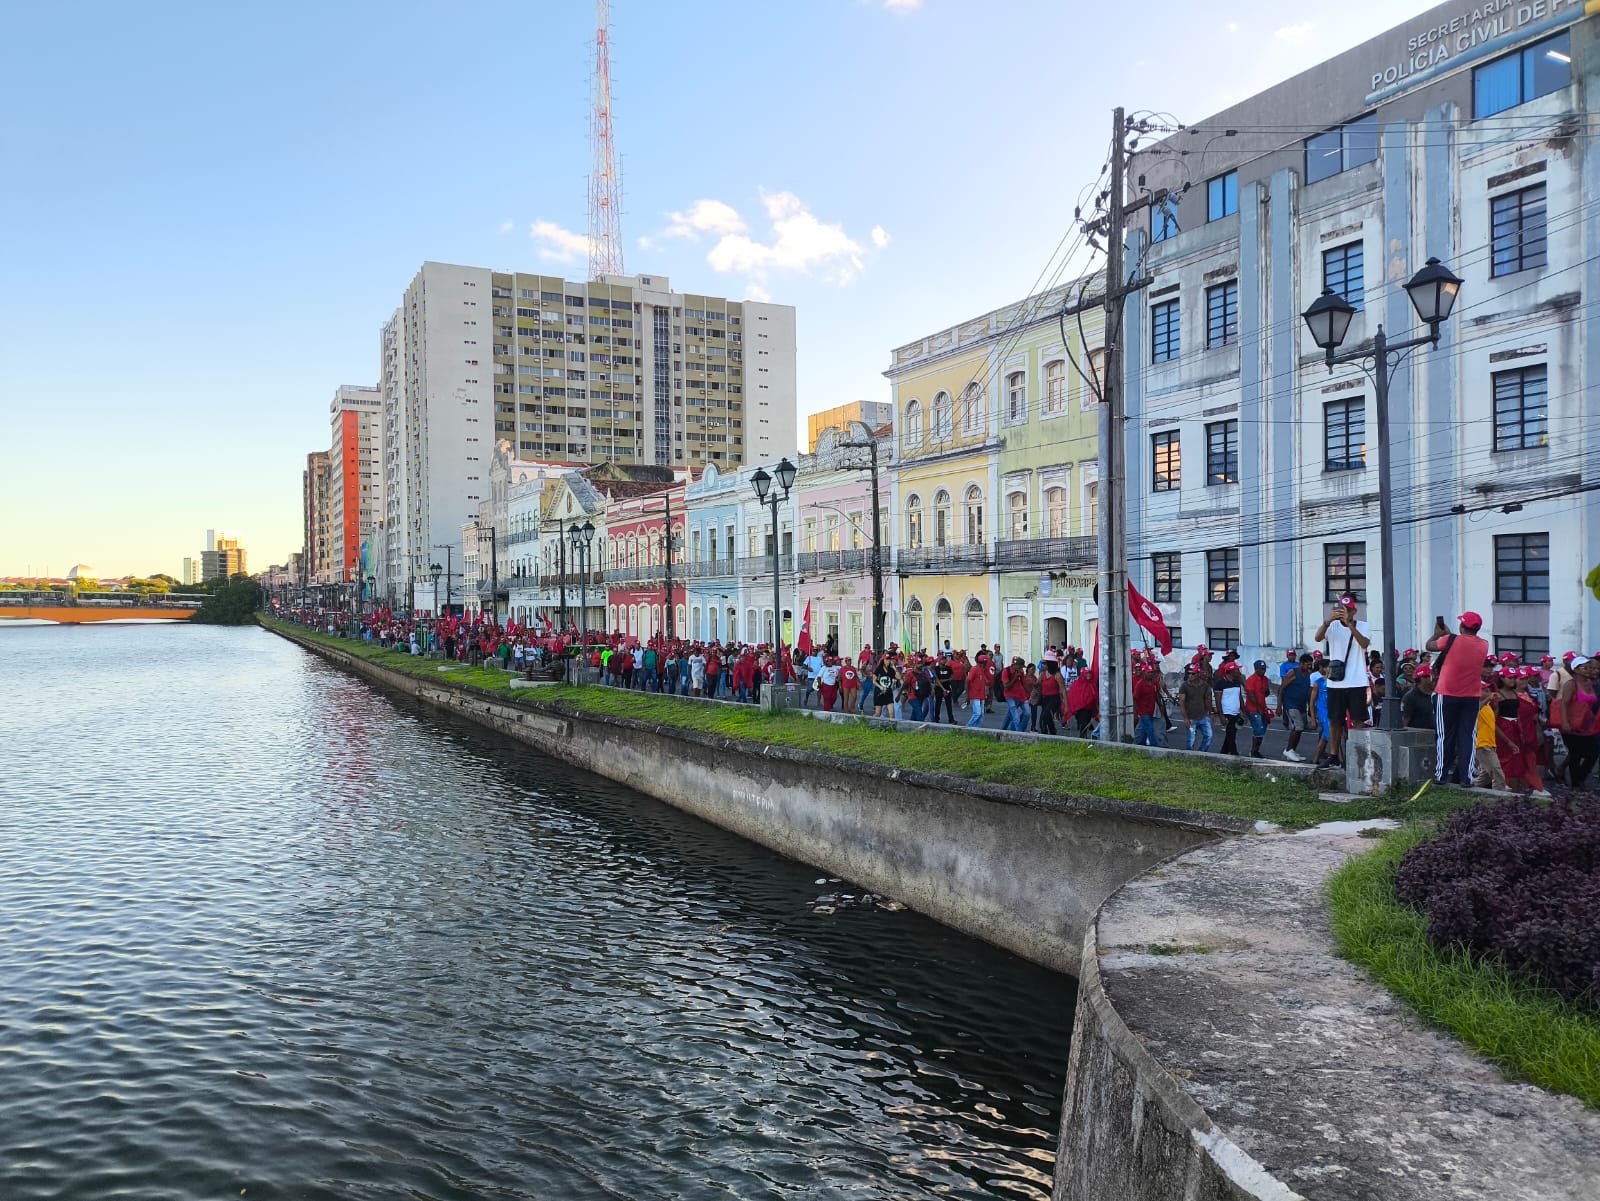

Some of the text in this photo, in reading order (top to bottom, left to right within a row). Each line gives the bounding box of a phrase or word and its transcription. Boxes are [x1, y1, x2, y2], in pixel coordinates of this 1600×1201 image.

[1408, 0, 1512, 51] SECRETARIA
[1457, 15, 1511, 51] CIVIL
[1518, 0, 1546, 26] DE
